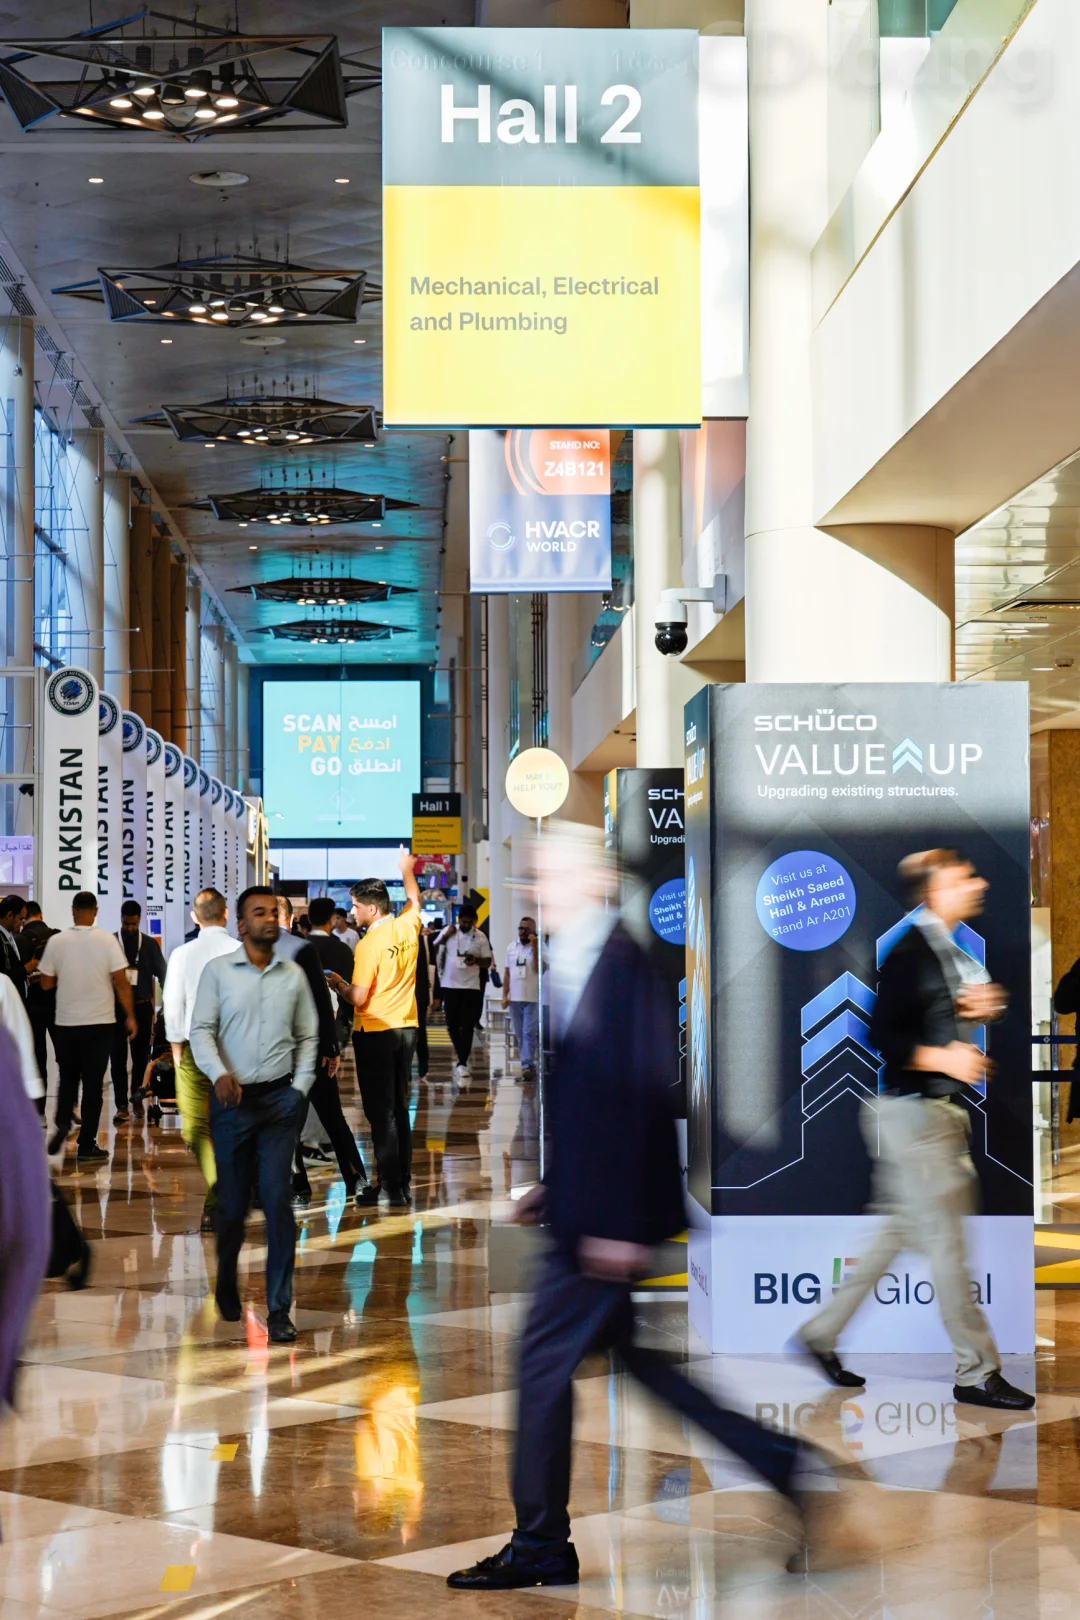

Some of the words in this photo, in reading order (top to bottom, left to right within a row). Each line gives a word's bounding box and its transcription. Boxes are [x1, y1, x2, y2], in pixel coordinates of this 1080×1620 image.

[440, 83, 578, 144] Hall
[600, 83, 642, 144] 2
[410, 276, 547, 298] Mechanical,
[553, 276, 659, 296] Electrical
[410, 312, 453, 331] and
[459, 312, 568, 334] Plumbing
[549, 441, 582, 450] STAND
[583, 441, 600, 450] NO:
[544, 461, 604, 477] Z4B121
[525, 520, 600, 538] HVACR
[526, 541, 577, 553] WORLD
[283, 714, 342, 732] SCAN
[348, 714, 397, 732] امسح
[754, 708, 877, 732] SCHÜCO
[298, 735, 341, 753] PAY
[348, 736, 390, 753] ادفع
[310, 756, 342, 776] GO
[348, 758, 401, 776] انطلق
[755, 743, 886, 776] VALUE
[929, 743, 983, 776] UP
[513, 784, 536, 792] HELP
[538, 782, 562, 791] YOU?
[758, 785, 828, 800] Upgrading
[832, 785, 883, 800] existing
[887, 786, 959, 797] structures.
[420, 801, 442, 812] Hall
[444, 802, 450, 811] 1
[58, 748, 83, 892] PAKISTAN
[770, 872, 797, 886] Visit
[800, 869, 813, 879] us
[816, 864, 828, 874] at
[659, 892, 676, 902] Visit
[763, 888, 804, 906] Sheikh
[808, 876, 844, 894] Saeed
[654, 902, 682, 916] Sheikh
[769, 904, 794, 919] Hall
[797, 901, 807, 912] &
[810, 892, 846, 908] Arena
[658, 913, 675, 924] Hall
[676, 910, 683, 919] &
[772, 919, 804, 936] stand
[806, 916, 819, 927] Ar
[823, 906, 851, 922] A201
[660, 924, 681, 936] stand
[754, 1272, 820, 1305] BIG
[874, 1272, 992, 1305] Gloal
